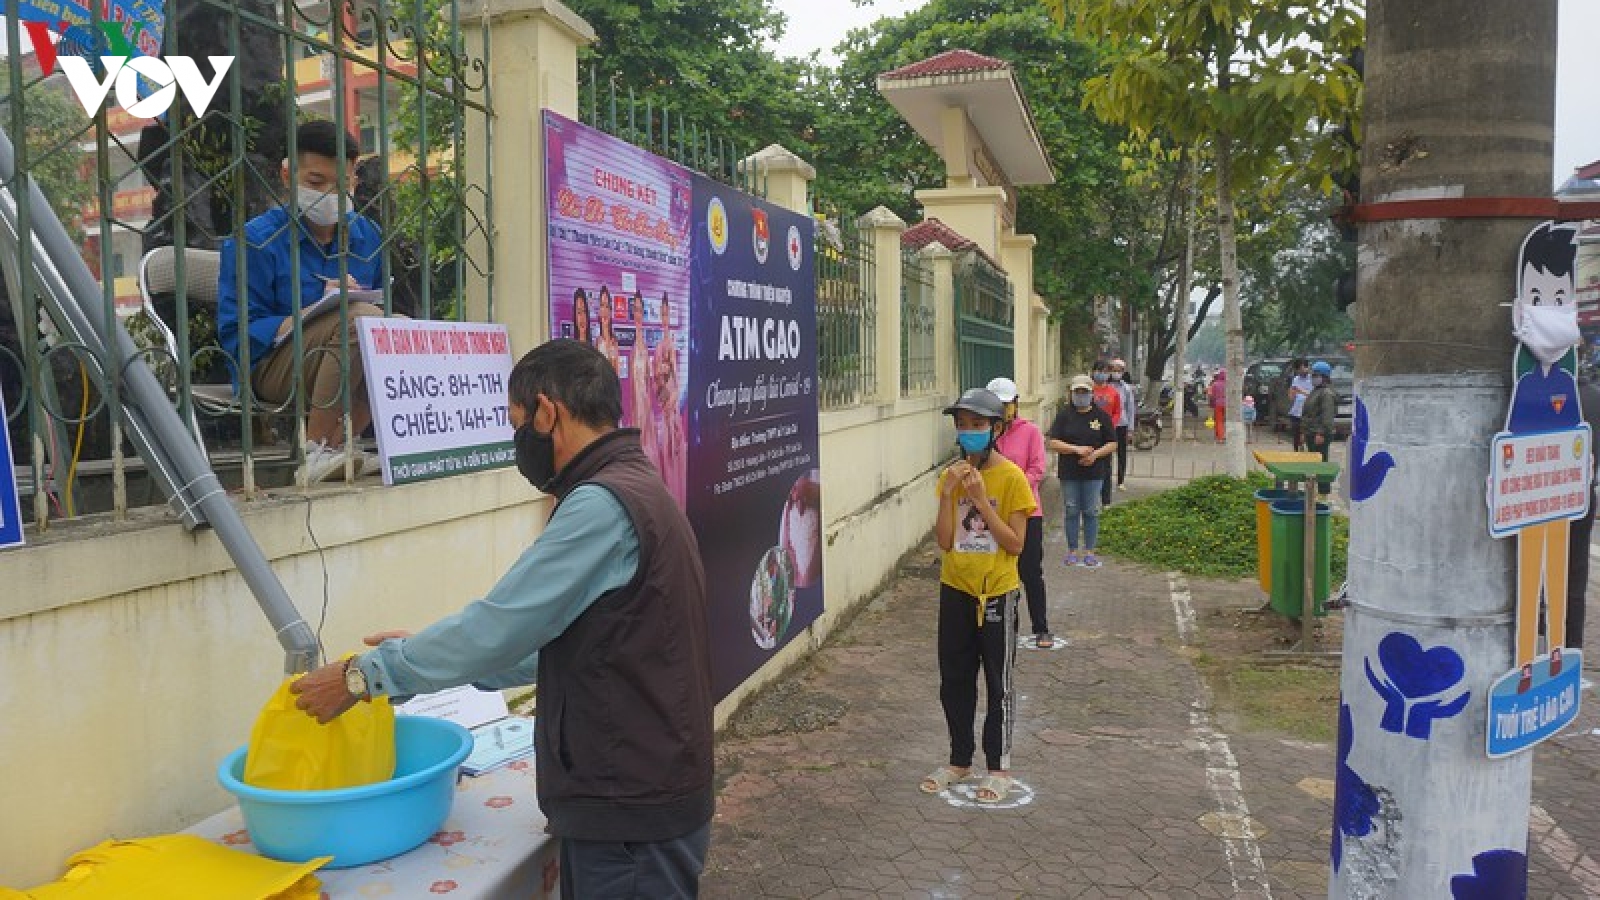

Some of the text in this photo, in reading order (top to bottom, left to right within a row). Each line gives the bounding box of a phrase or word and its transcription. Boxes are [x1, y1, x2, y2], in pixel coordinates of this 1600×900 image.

[718, 315, 801, 365] ATM GẠO
[384, 369, 503, 401] SÁNG: 8H-11H
[705, 378, 737, 418] Chung
[456, 405, 511, 431] 14H-17
[1496, 683, 1575, 739] TUỔI TRẺ LÀO CAI
